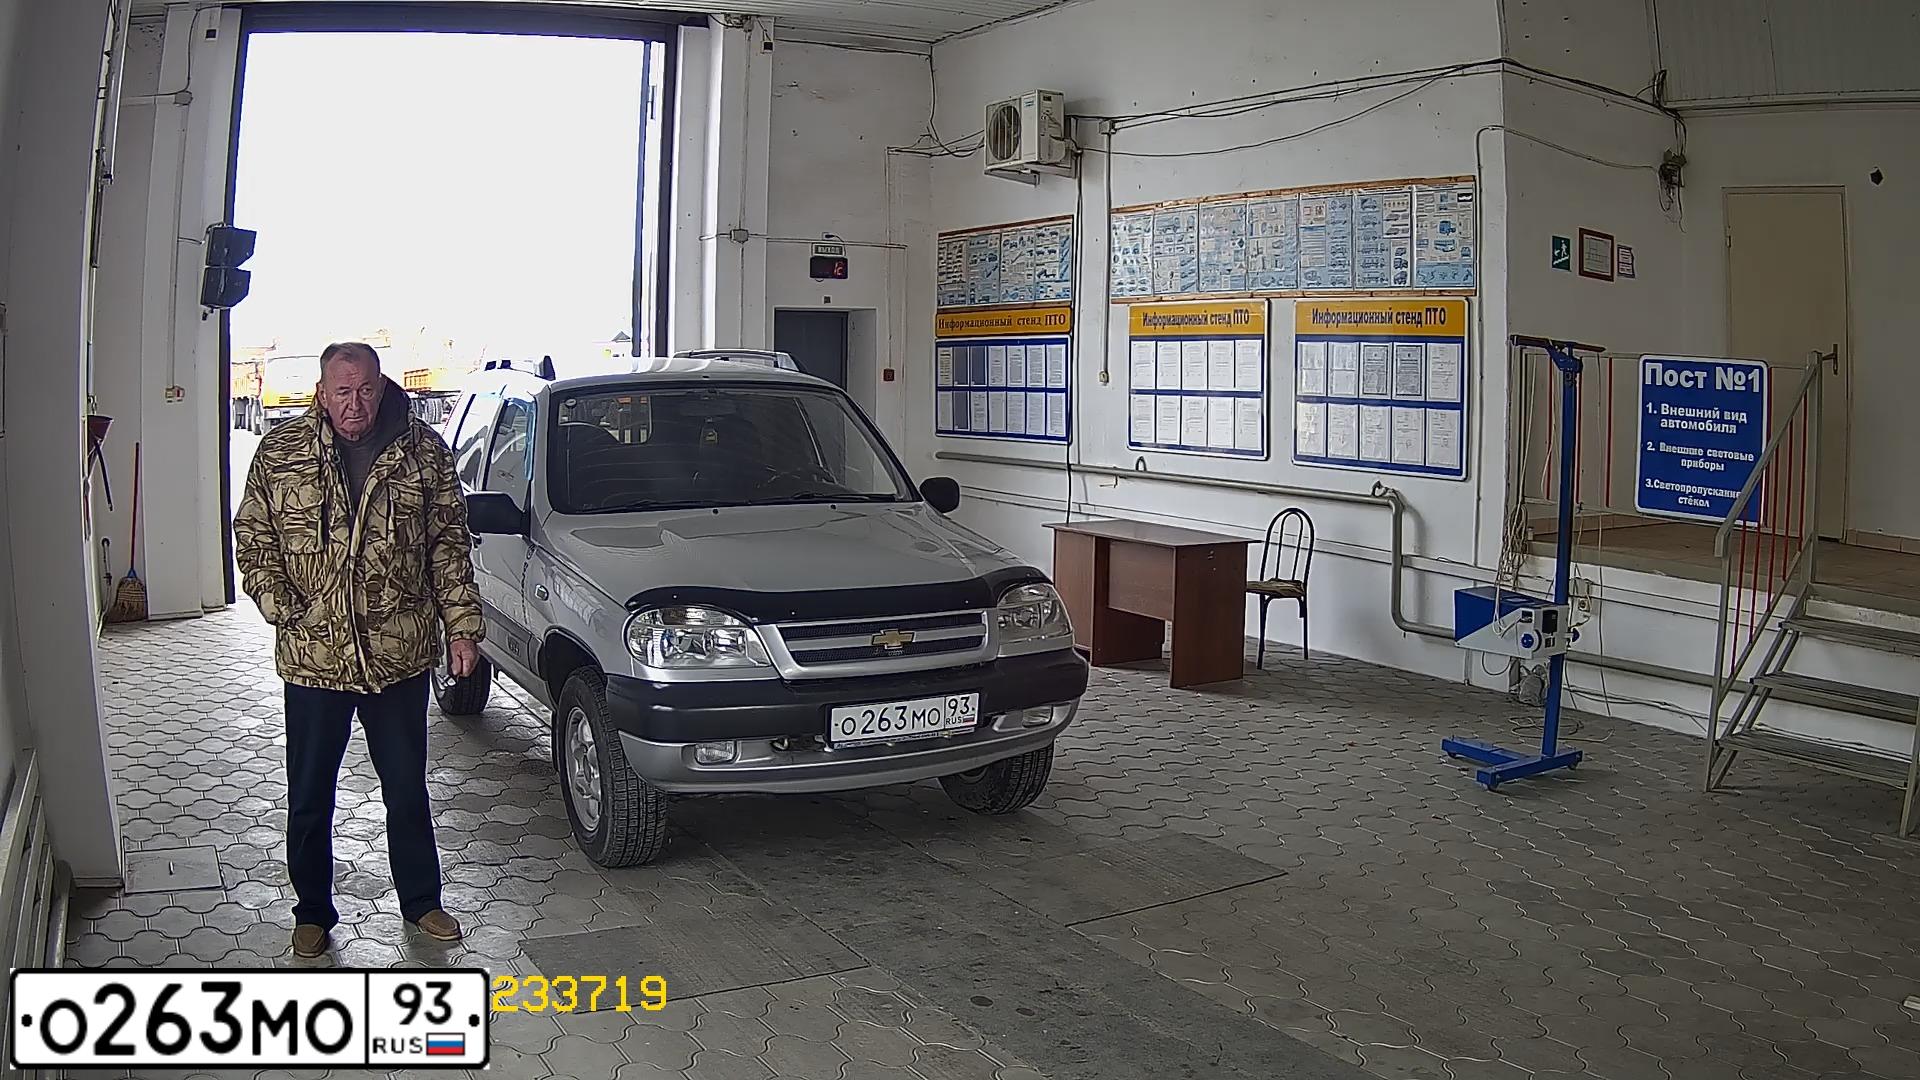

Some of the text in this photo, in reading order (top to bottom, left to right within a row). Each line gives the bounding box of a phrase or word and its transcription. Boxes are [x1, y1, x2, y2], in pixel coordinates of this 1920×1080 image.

[938, 314, 1066, 331] Информационный стенд ПТО
[1142, 308, 1250, 330] Информационный стенд ПТО
[1312, 307, 1446, 328] Информационный стенд ПТО
[1645, 362, 1760, 392] Пост №1
[1646, 402, 1748, 424] 1. Внешний вид
[1660, 418, 1737, 434] автомобиля
[1646, 442, 1754, 462] 2. Внешние световые
[1681, 460, 1724, 472] приборы
[948, 696, 970, 717] 93
[946, 715, 962, 725] RUS
